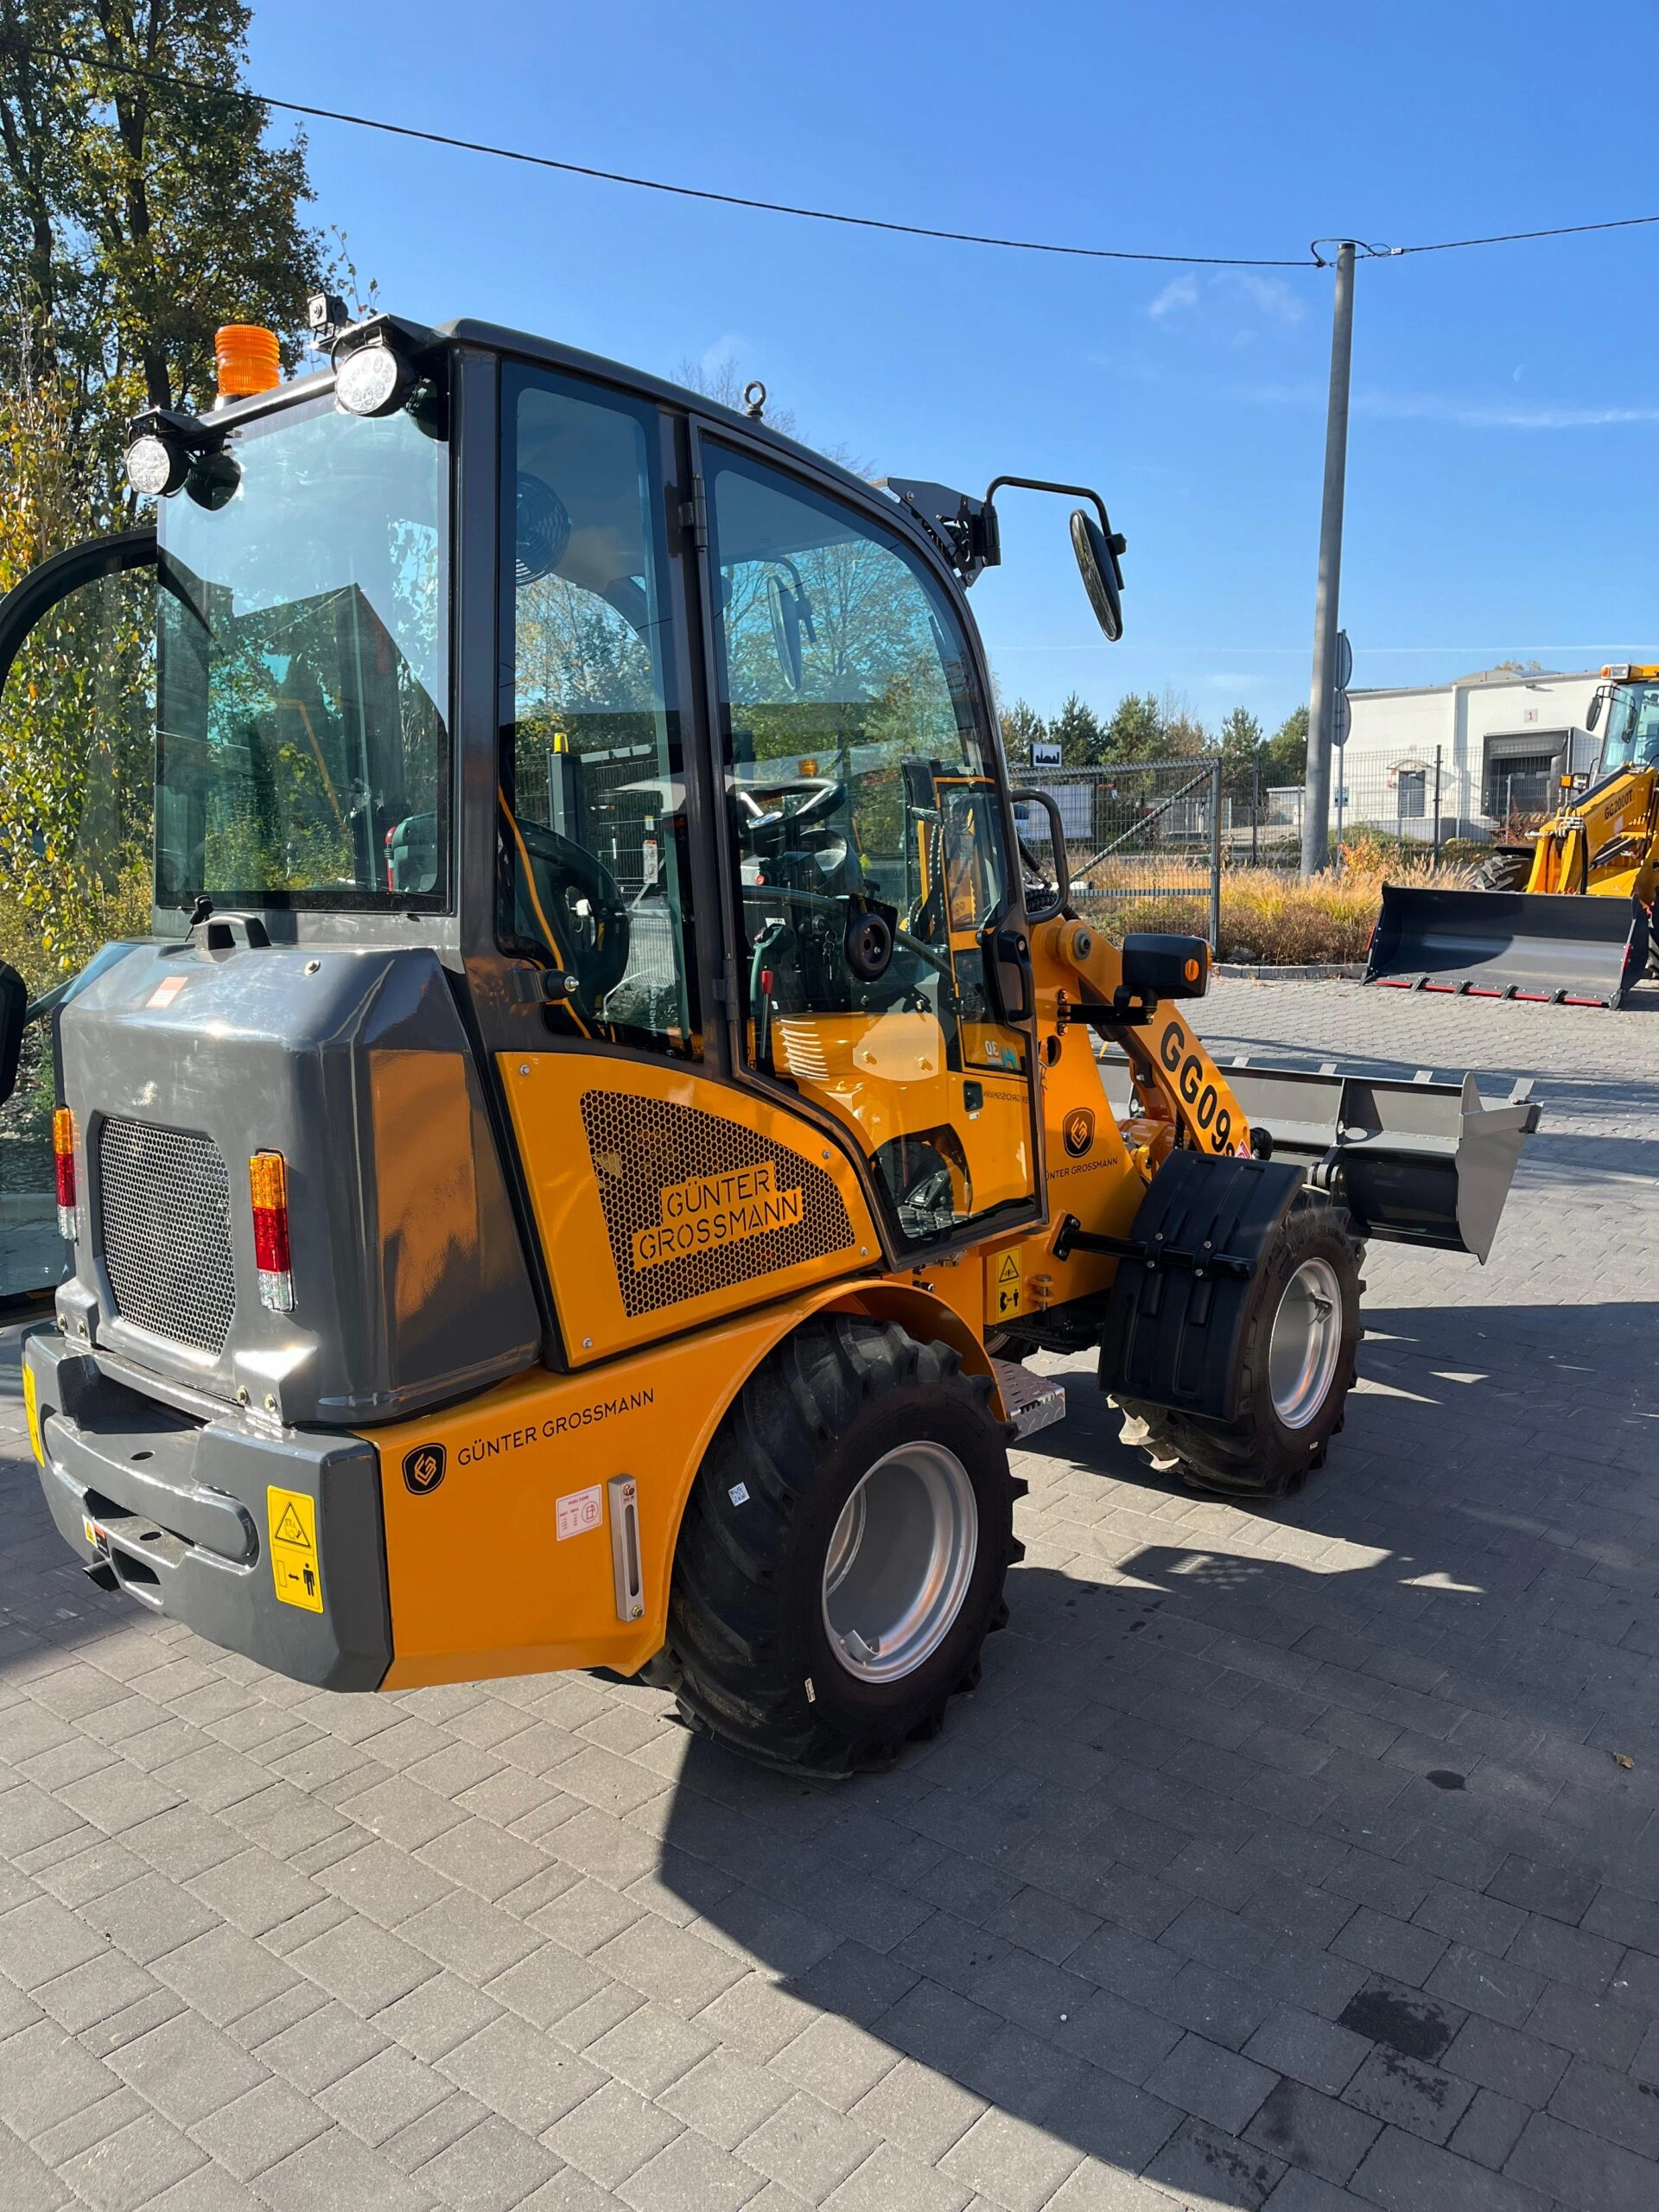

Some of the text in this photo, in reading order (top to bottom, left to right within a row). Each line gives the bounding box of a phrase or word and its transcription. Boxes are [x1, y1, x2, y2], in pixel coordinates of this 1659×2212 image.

[1528, 712, 1534, 721] 1
[1605, 789, 1633, 820] GG2000T
[1046, 1157, 1118, 1181] ÜNTER GROSSMANN
[667, 1169, 770, 1217] GÜNTER
[639, 1192, 798, 1260] GROSSMANN
[458, 1388, 654, 1465] GÜNTER GROSSMANN
